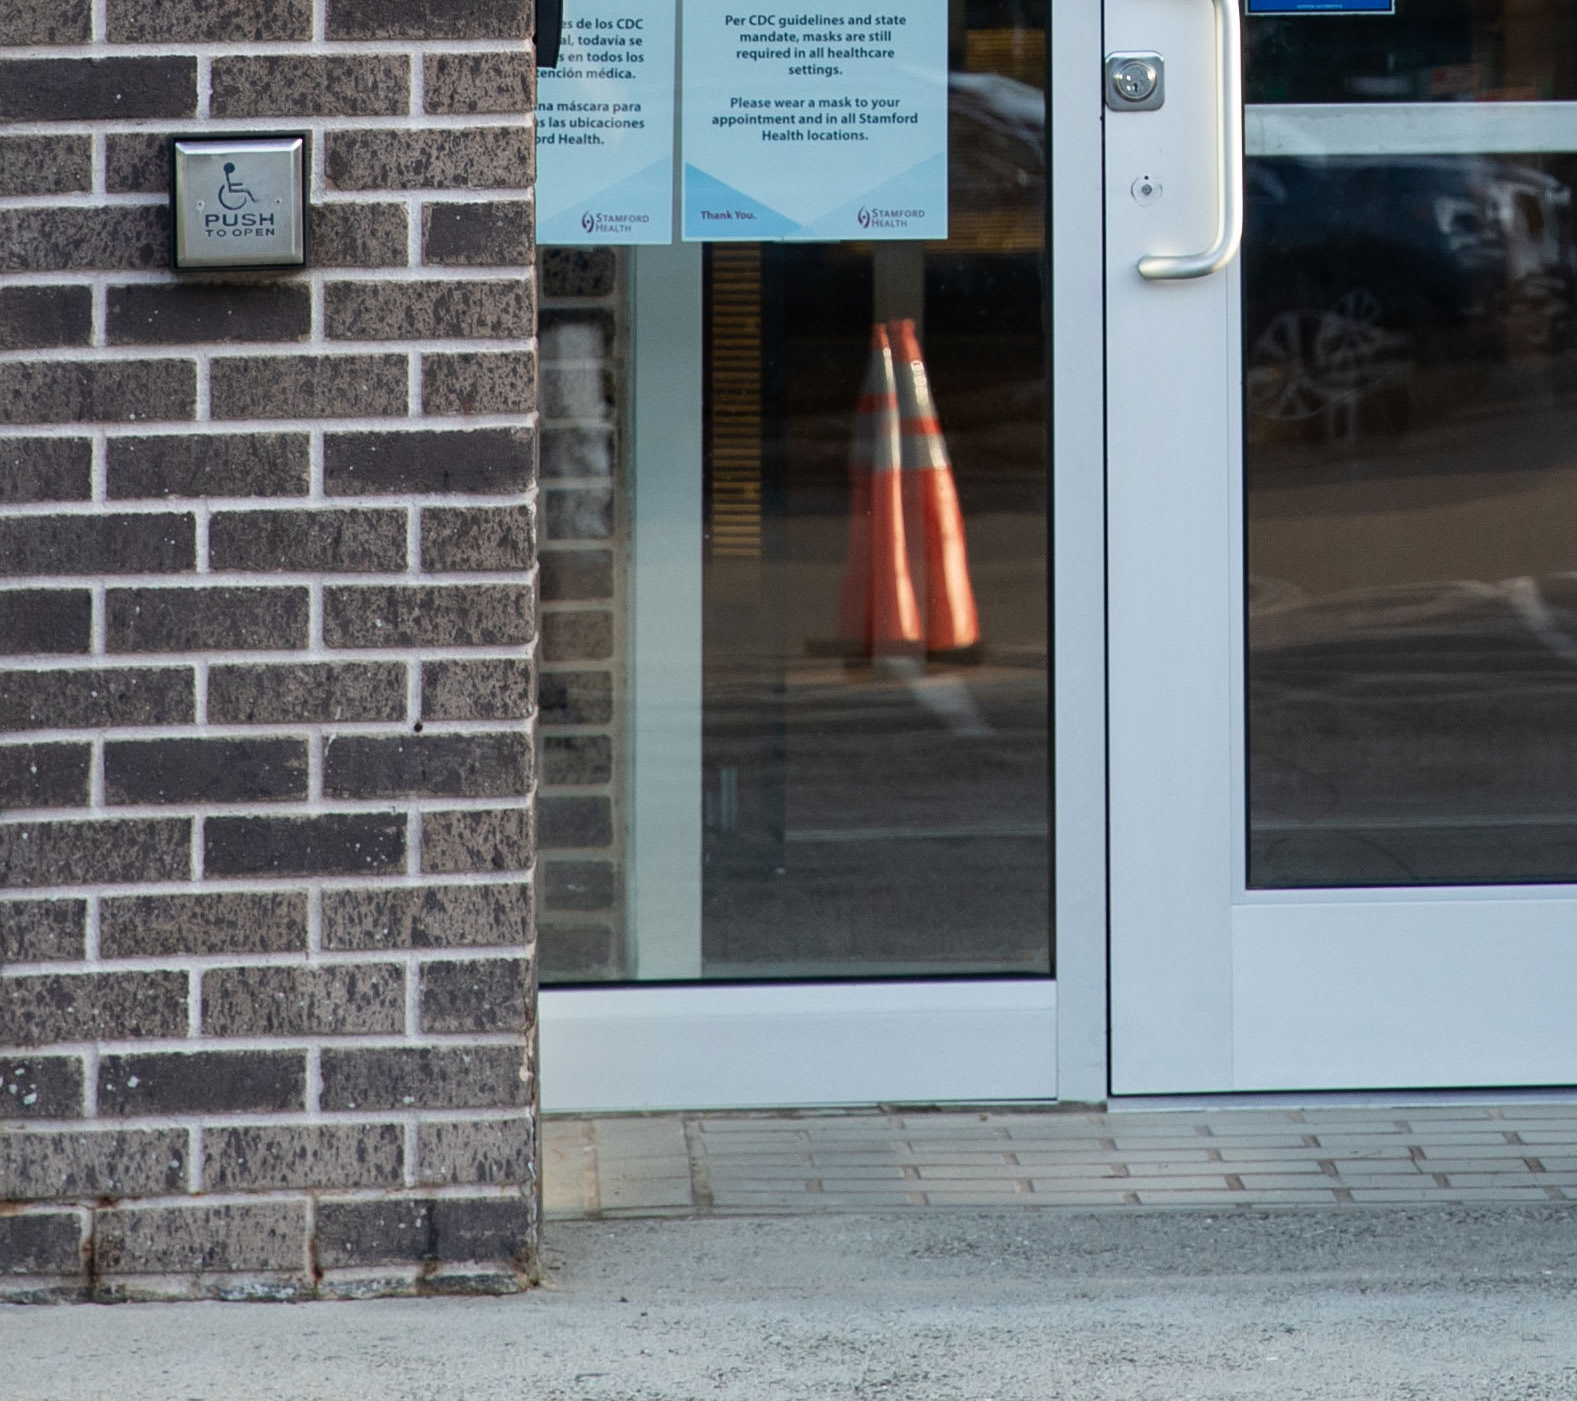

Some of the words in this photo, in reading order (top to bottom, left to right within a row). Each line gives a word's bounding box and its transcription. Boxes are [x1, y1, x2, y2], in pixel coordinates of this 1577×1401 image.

[576, 18, 592, 29] de
[595, 18, 613, 30] los
[616, 18, 643, 30] CDC
[725, 15, 746, 26] Per
[749, 15, 775, 26] CDC
[778, 14, 845, 29] guidelines
[848, 14, 872, 25] and
[875, 15, 906, 25] state
[578, 34, 626, 46] todavía
[629, 37, 643, 46] se
[740, 31, 799, 43] mandate,
[803, 31, 842, 42] masks
[845, 33, 865, 42] are
[869, 30, 891, 42] still
[568, 54, 583, 62] en
[587, 51, 623, 62] todos
[626, 51, 644, 63] los
[736, 47, 791, 61] required
[794, 47, 806, 58] in
[809, 47, 824, 58] all
[827, 47, 895, 58] healthcare
[586, 68, 636, 79] médica.
[788, 64, 842, 78] settings.
[538, 103, 554, 111] na
[557, 100, 609, 112] máscara
[613, 103, 641, 114] para
[730, 97, 771, 108] Please
[774, 99, 805, 108] wear
[808, 99, 815, 108] a
[818, 96, 852, 108] mask
[855, 98, 868, 108] to
[871, 99, 900, 110] your
[549, 116, 566, 128] las
[569, 116, 645, 129] ubicaciones
[712, 113, 795, 127] appointment
[798, 113, 822, 124] and
[826, 113, 837, 124] in
[841, 113, 856, 124] all
[859, 112, 918, 124] Stamford
[558, 133, 604, 145] Health.
[762, 130, 804, 141] Health
[807, 129, 868, 141] locations.
[596, 213, 649, 223] STAMFORD
[700, 210, 733, 220] Thank
[734, 210, 756, 220] You.
[872, 208, 925, 218] STAMFORD
[205, 213, 274, 227] PUSH
[871, 217, 907, 228] HEALTH
[205, 229, 227, 237] TO
[232, 228, 275, 237] OPEN
[595, 223, 631, 233] HEALTH
